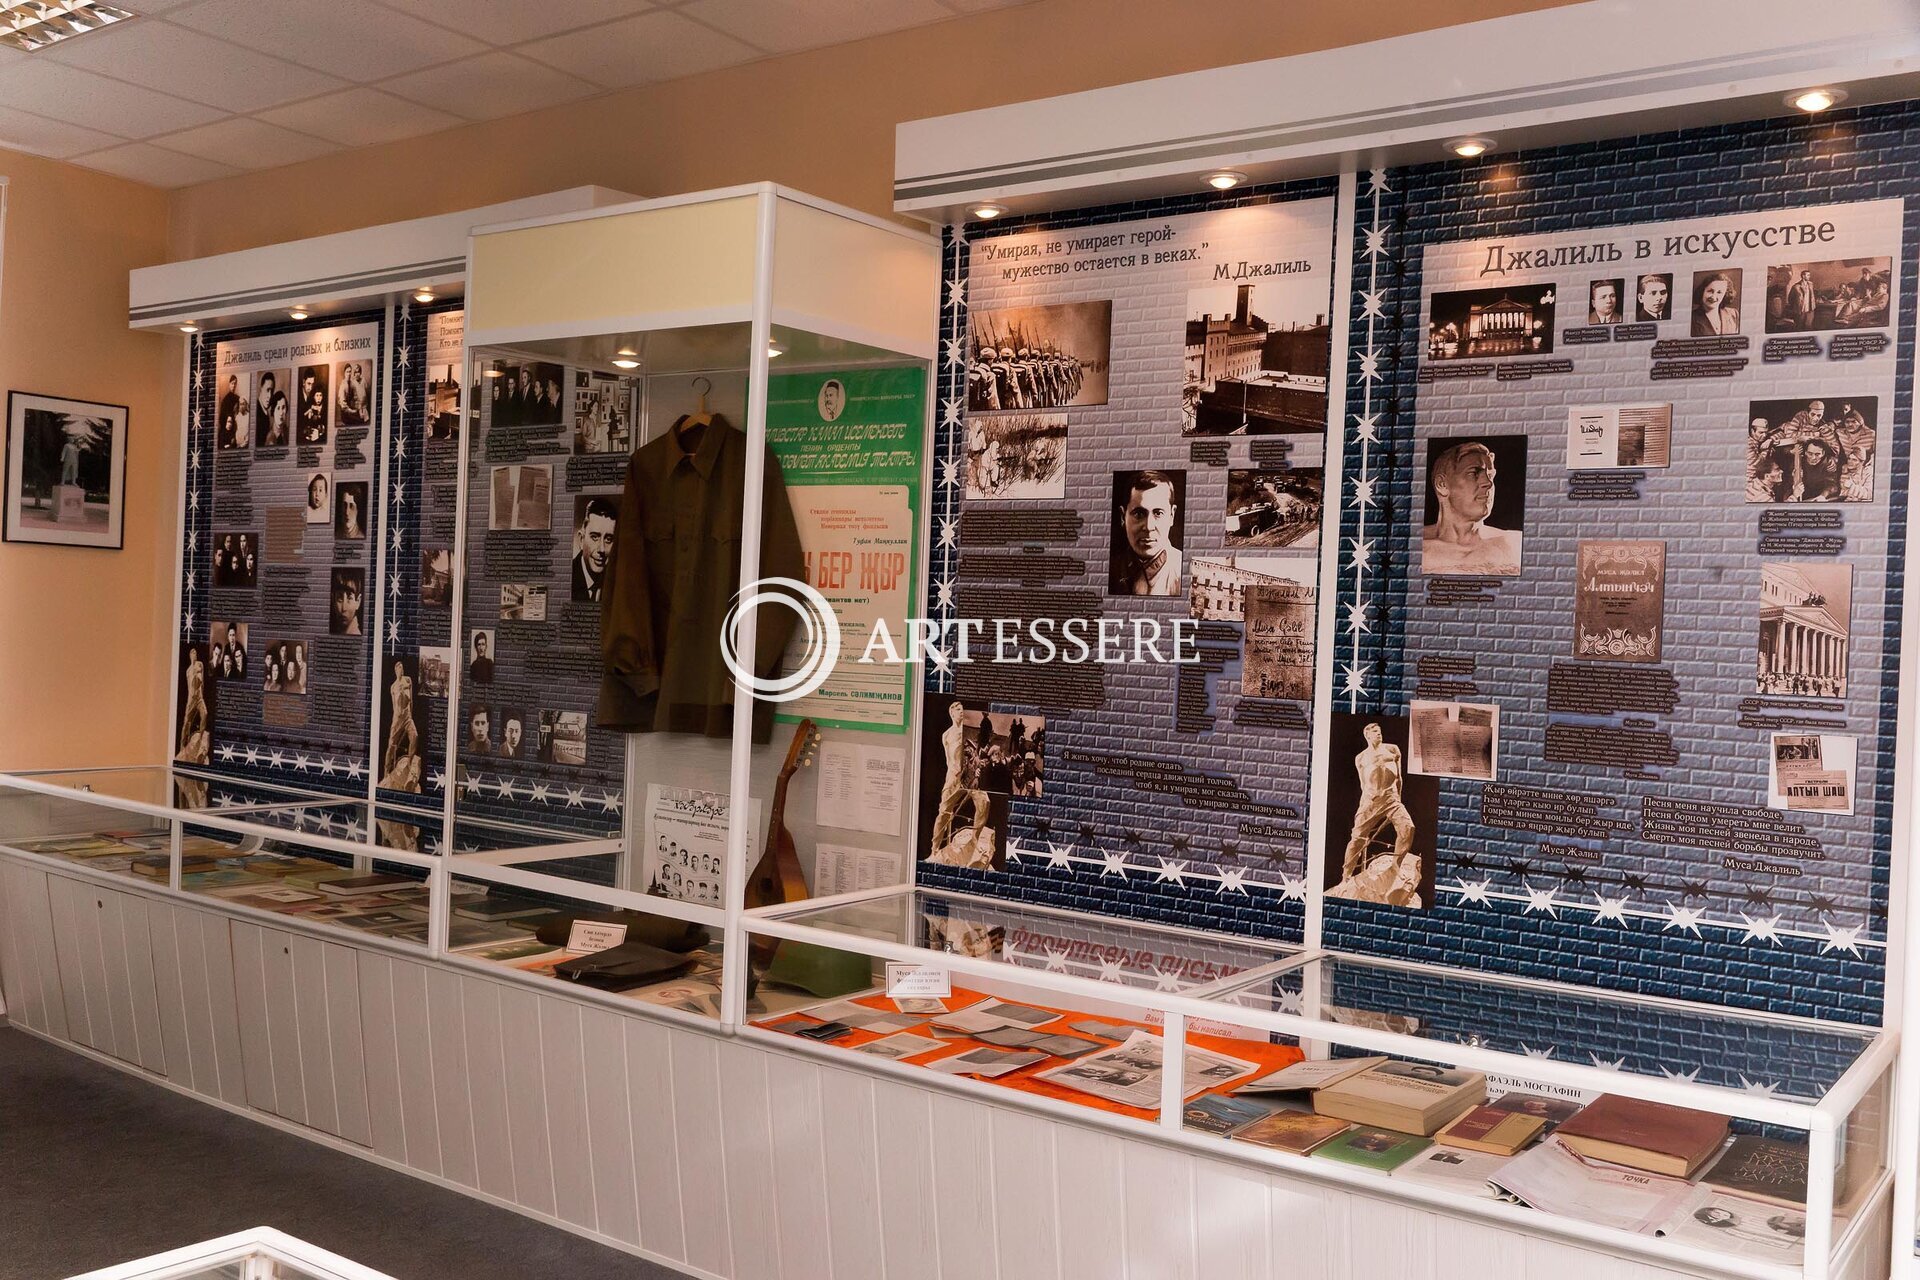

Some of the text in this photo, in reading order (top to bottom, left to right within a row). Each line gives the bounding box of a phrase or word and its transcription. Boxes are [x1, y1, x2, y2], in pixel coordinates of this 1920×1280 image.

[1046, 241, 1062, 254] не
[1067, 233, 1126, 252] умирает
[1130, 226, 1177, 244] герой-
[1480, 219, 1836, 277] Джалиль в искусстве
[1002, 261, 1070, 280] мужество
[1074, 256, 1136, 271] остается
[1141, 256, 1149, 266] в
[1213, 261, 1312, 281] М.Джалиль
[224, 351, 261, 366] Джалиль
[264, 348, 288, 363] среди
[291, 344, 322, 360] родных
[334, 337, 371, 351] близких
[440, 339, 450, 348] Кто
[818, 552, 853, 588] БЕР
[1071, 753, 1089, 761] жить
[1112, 757, 1128, 765] чтоб
[1129, 759, 1155, 768] родине
[1157, 762, 1182, 771] отдать
[1097, 766, 1236, 787] последний сердца движущий толчок,
[1136, 781, 1152, 789] чтоб
[1170, 785, 1200, 796] умирая,
[1217, 791, 1249, 800] сказать,
[1507, 788, 1540, 799] өйрәтте
[1542, 792, 1564, 800] мине
[1566, 795, 1581, 804] хөр
[1584, 797, 1615, 806] яшәргә
[1823, 786, 1845, 796] ШАШ
[1199, 799, 1229, 809] умираю
[1242, 804, 1297, 816] отчизну-мать.
[1516, 809, 1543, 819] минем
[1576, 815, 1591, 825] бер
[1533, 801, 1552, 810] кыю
[1554, 804, 1564, 813] ир
[1567, 804, 1597, 815] булып.
[1643, 797, 1783, 820] Песня меня научила свободе,
[1516, 820, 1526, 828] дә
[1578, 826, 1608, 839] булып.
[1643, 809, 1805, 834] Песня борцом умереть мне велит.
[1240, 824, 1303, 839] Муса Джалиль
[1644, 820, 1676, 831] Жизнь
[1678, 825, 1696, 834] моя
[1699, 827, 1731, 838] песней
[1734, 831, 1771, 841] звенела
[1782, 837, 1820, 847] народе,
[1541, 844, 1566, 855] Муса
[1642, 831, 1825, 859] Смерть моя песней борьбы прозвучит.
[1724, 858, 1801, 876] Муса Джалиль
[1012, 929, 1154, 970] Фронтовые
[1144, 1014, 1159, 1023] Вам
[1524, 1081, 1581, 1098] МОСТАФИН
[1622, 1174, 1650, 1185] ТОЧКА
